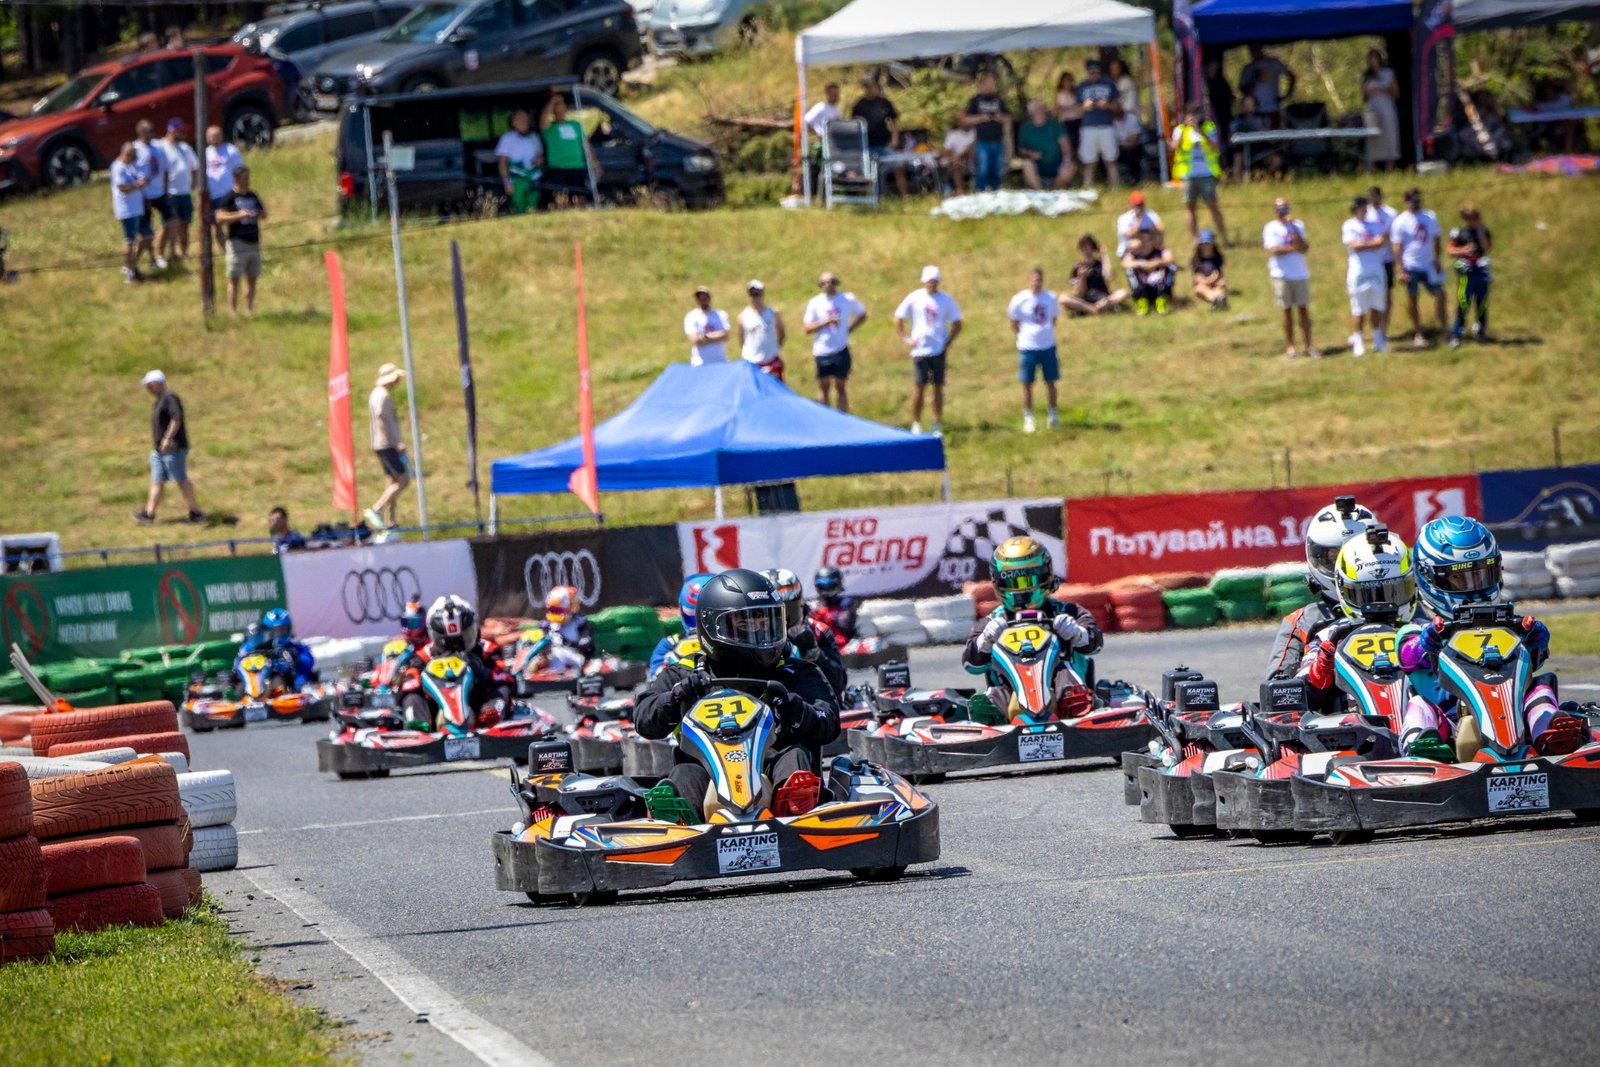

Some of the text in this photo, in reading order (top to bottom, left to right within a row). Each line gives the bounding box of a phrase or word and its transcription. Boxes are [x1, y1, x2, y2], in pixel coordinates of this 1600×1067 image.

[826, 515, 878, 539] EKO
[1089, 520, 1226, 559] Пътувай
[1231, 523, 1278, 550] на
[822, 535, 929, 571] racing
[1008, 629, 1041, 644] 10
[1473, 633, 1493, 649] 7
[1356, 637, 1396, 655] 20
[1187, 687, 1216, 695] KARTING
[1272, 687, 1303, 695] KARTING
[703, 699, 748, 719] 31
[1020, 734, 1063, 744] KARTING
[538, 751, 568, 760] KARTING
[1489, 774, 1547, 788] KARTING
[719, 833, 778, 849] KARTING
